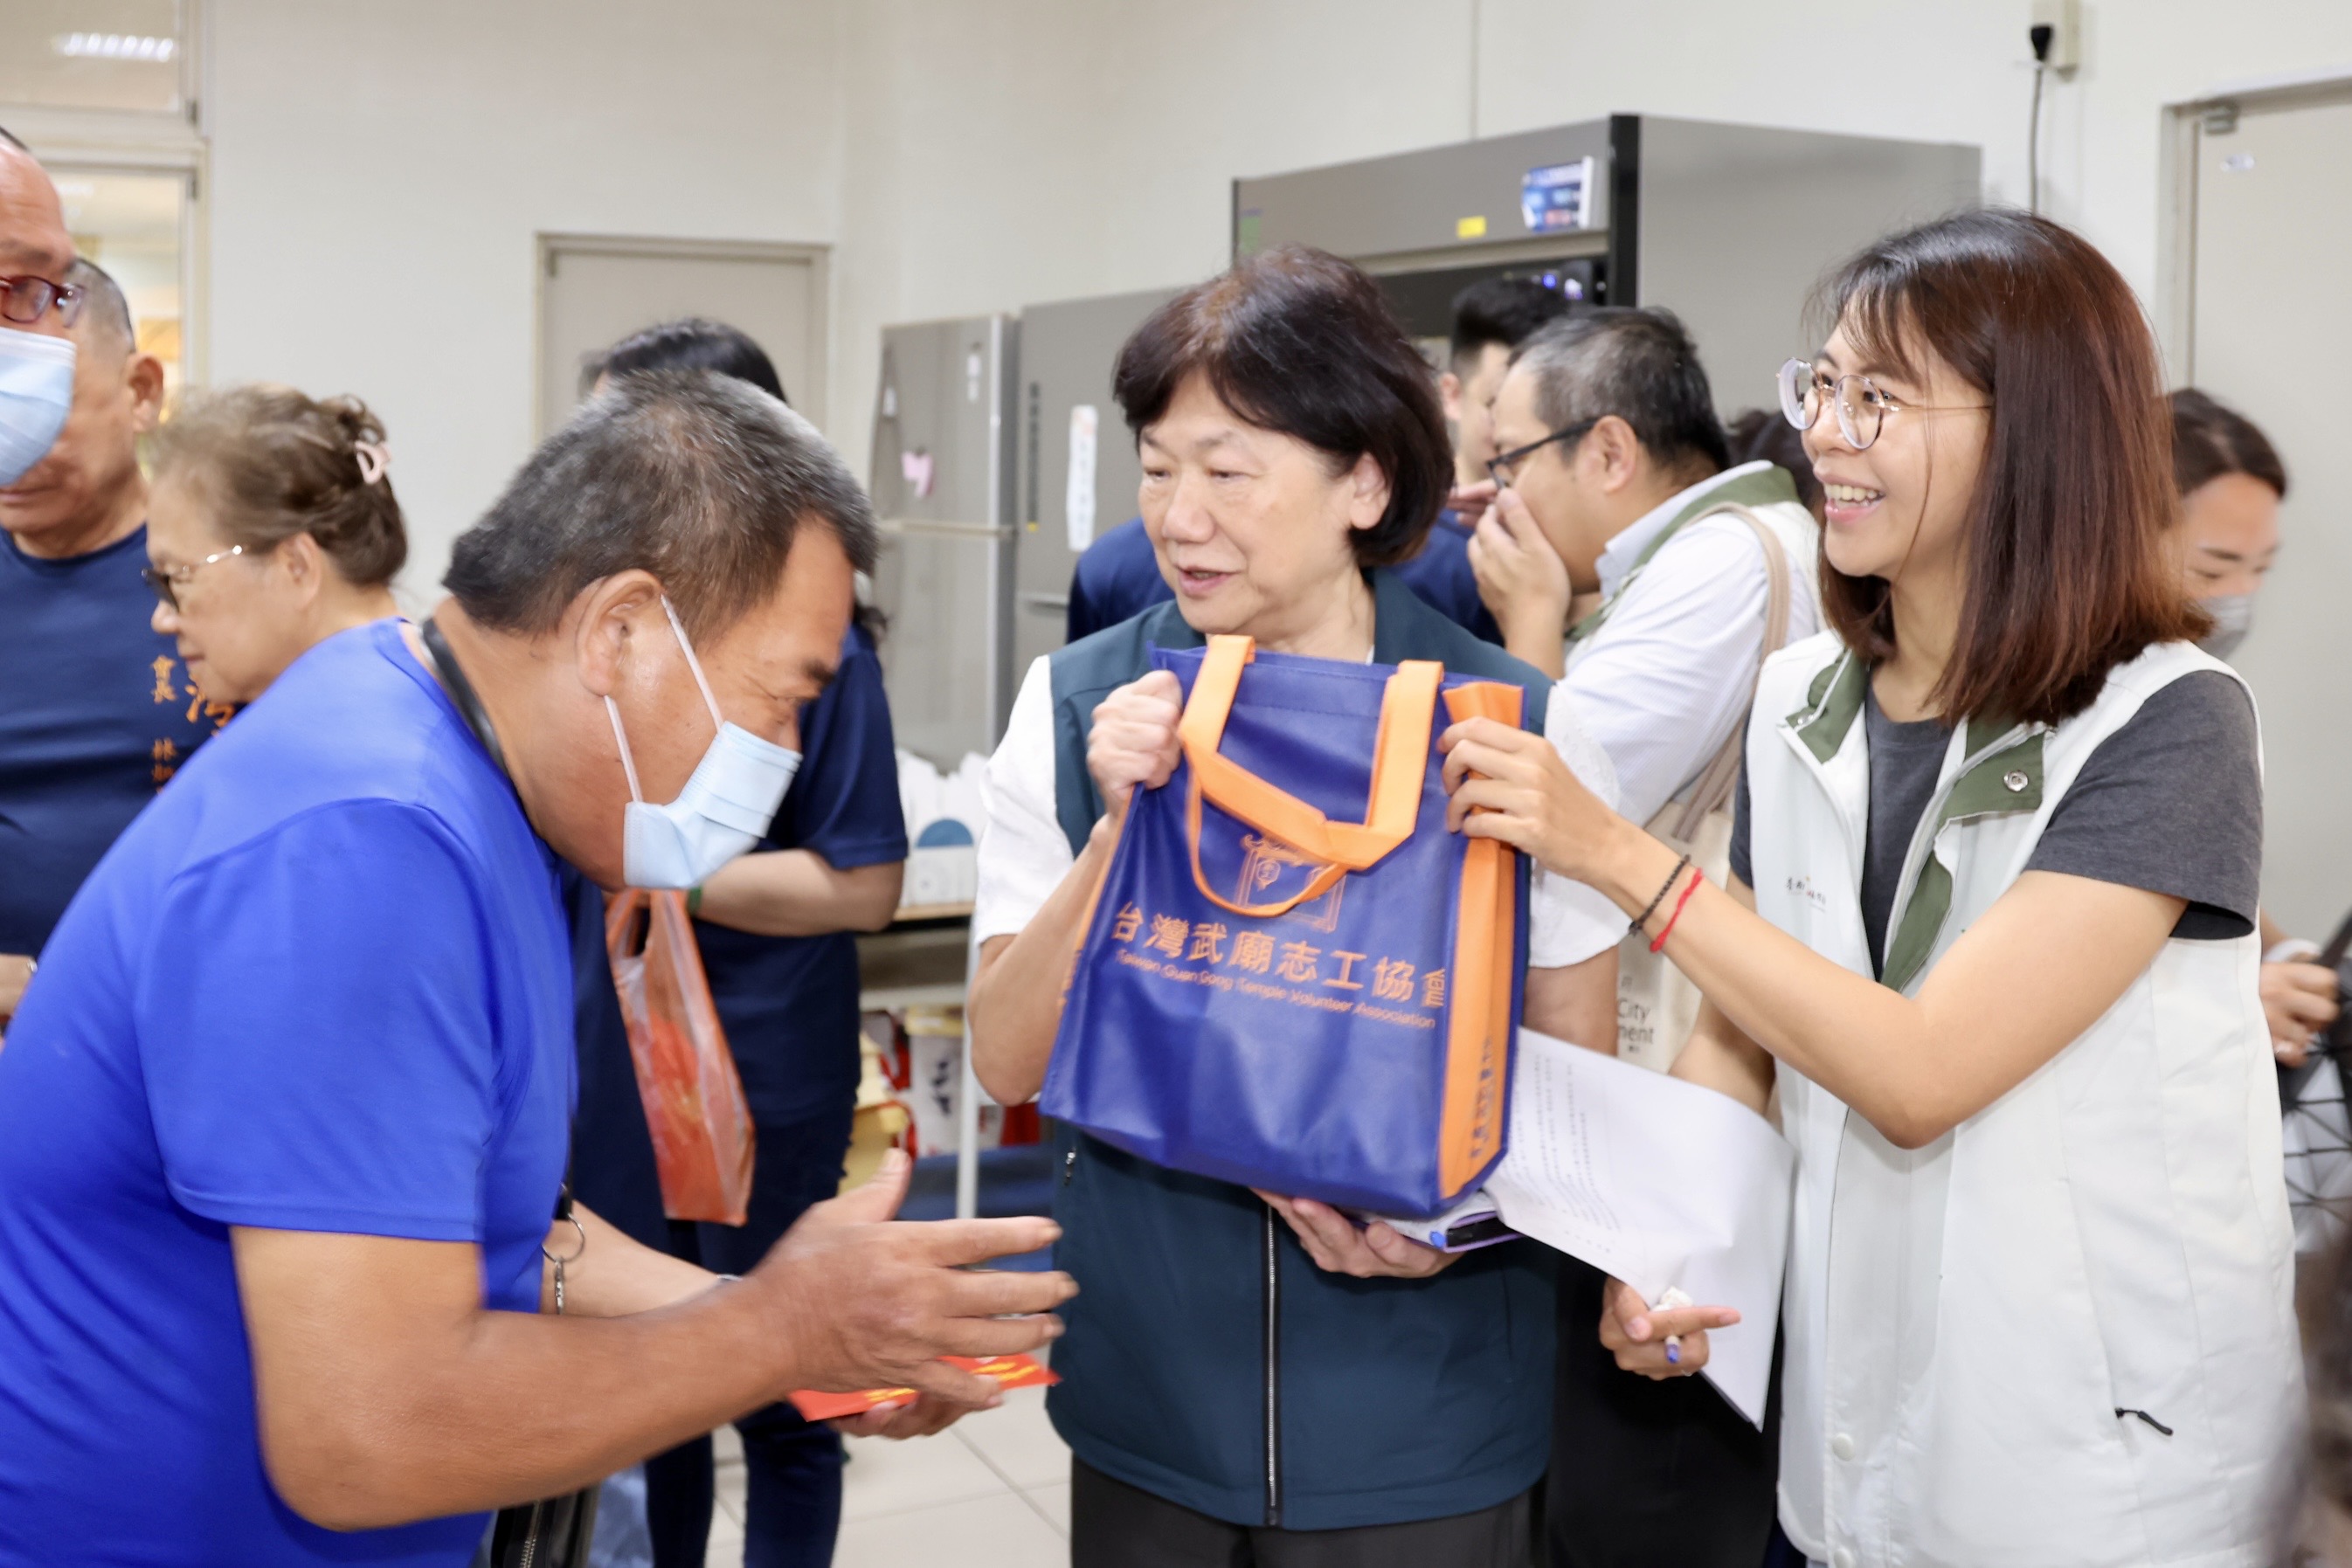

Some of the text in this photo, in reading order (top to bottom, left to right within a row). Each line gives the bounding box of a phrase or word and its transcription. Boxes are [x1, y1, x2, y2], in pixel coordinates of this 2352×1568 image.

[1237, 977, 1287, 1000] Temple
[1289, 989, 1353, 1013] Volunteer
[1353, 1002, 1435, 1029] Association
